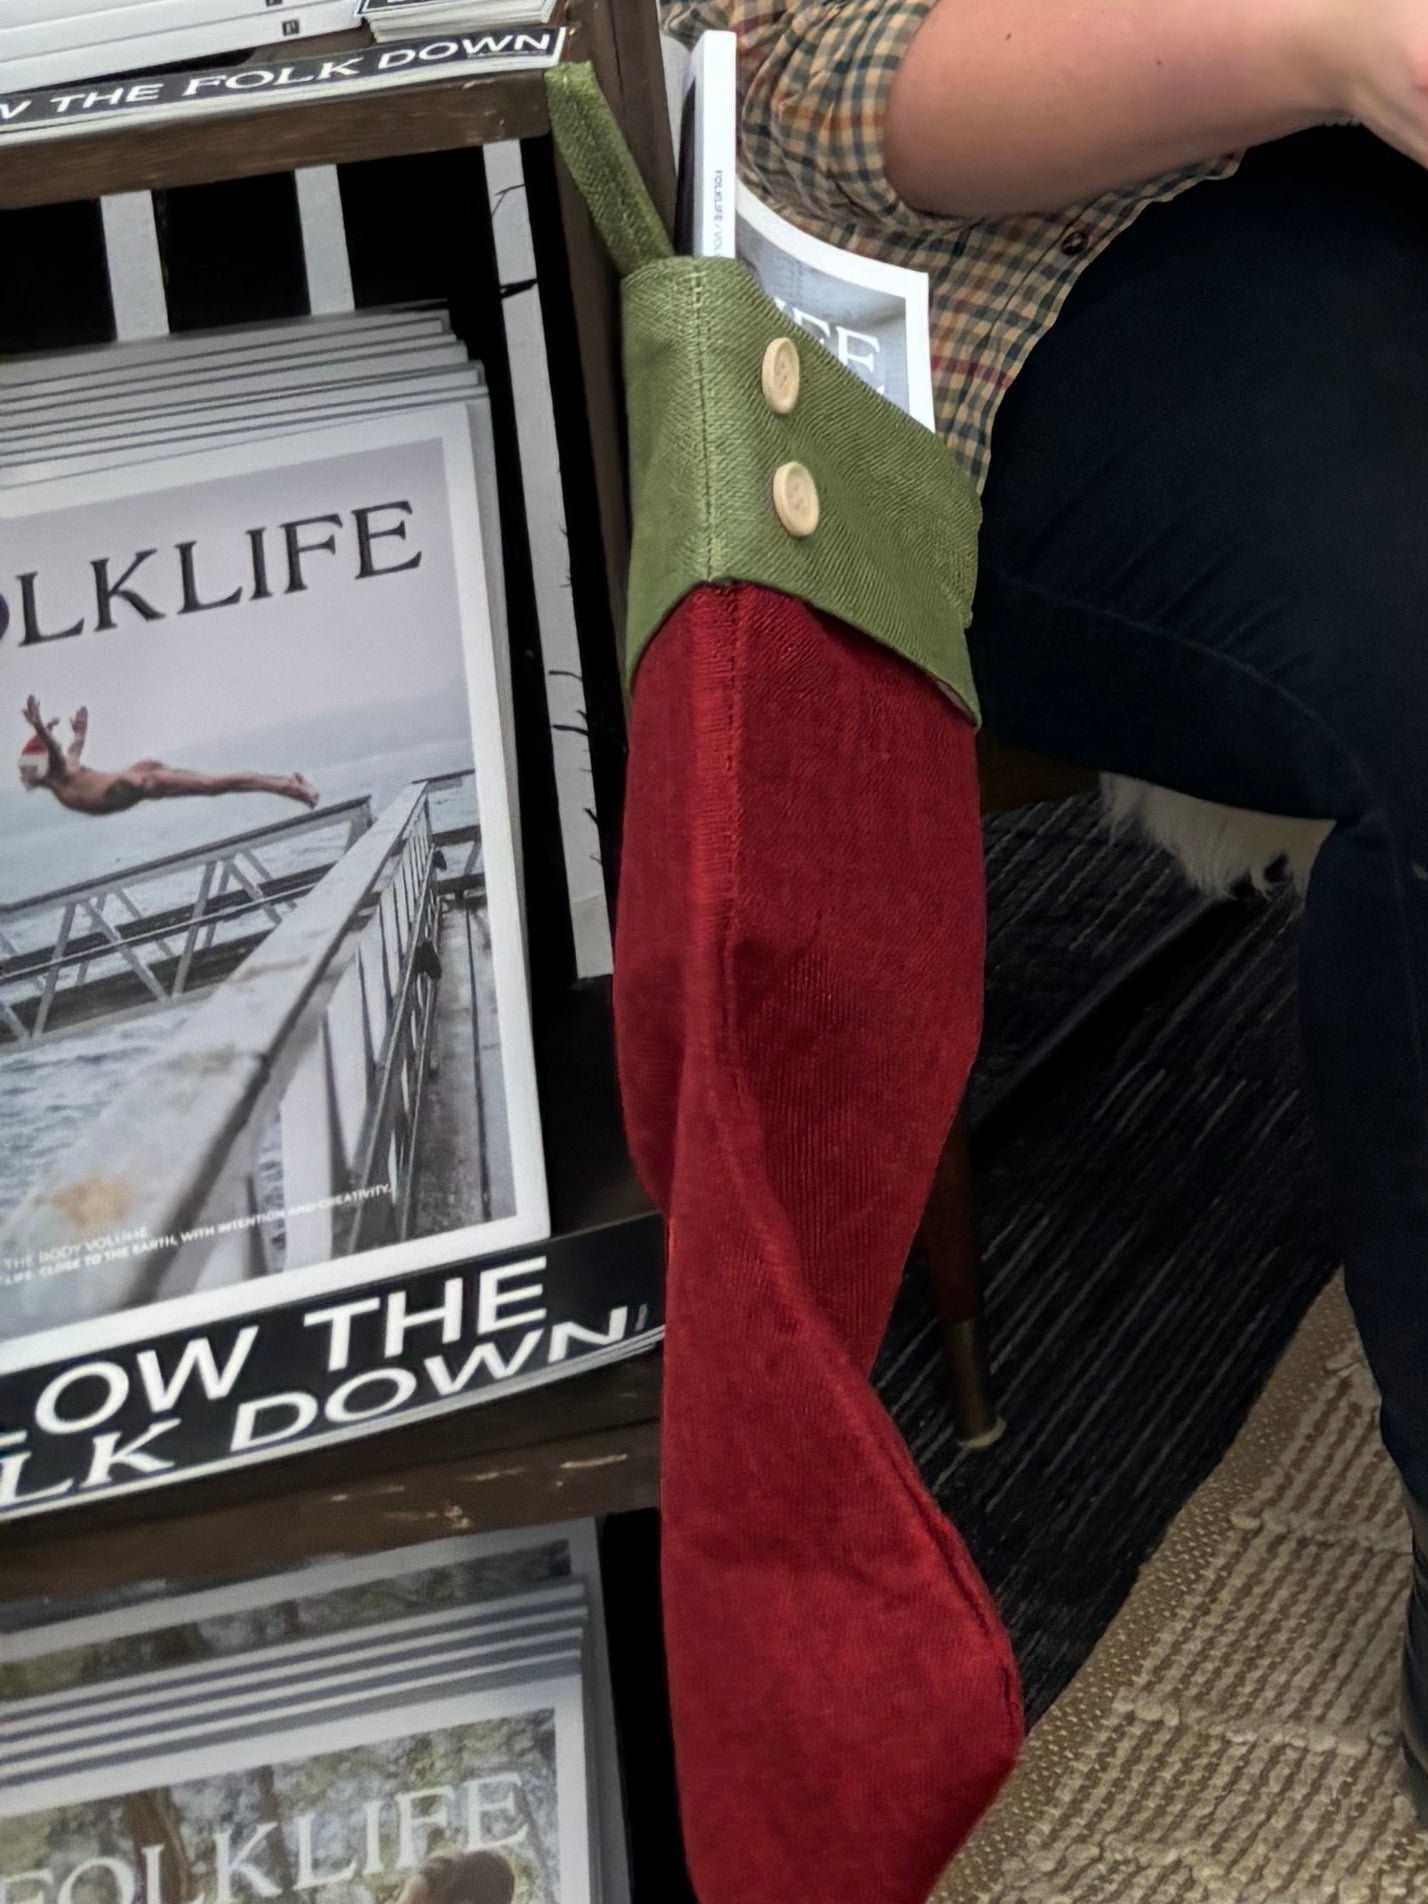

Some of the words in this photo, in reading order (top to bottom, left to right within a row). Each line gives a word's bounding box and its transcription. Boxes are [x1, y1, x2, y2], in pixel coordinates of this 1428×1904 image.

[50, 83, 163, 114] THE
[185, 56, 365, 96] FOLK
[378, 33, 550, 70] DOWN
[0, 500, 423, 647] LKLIFE
[304, 1256, 547, 1372] THE
[0, 1419, 181, 1500] LK
[230, 1306, 629, 1452] DOWN
